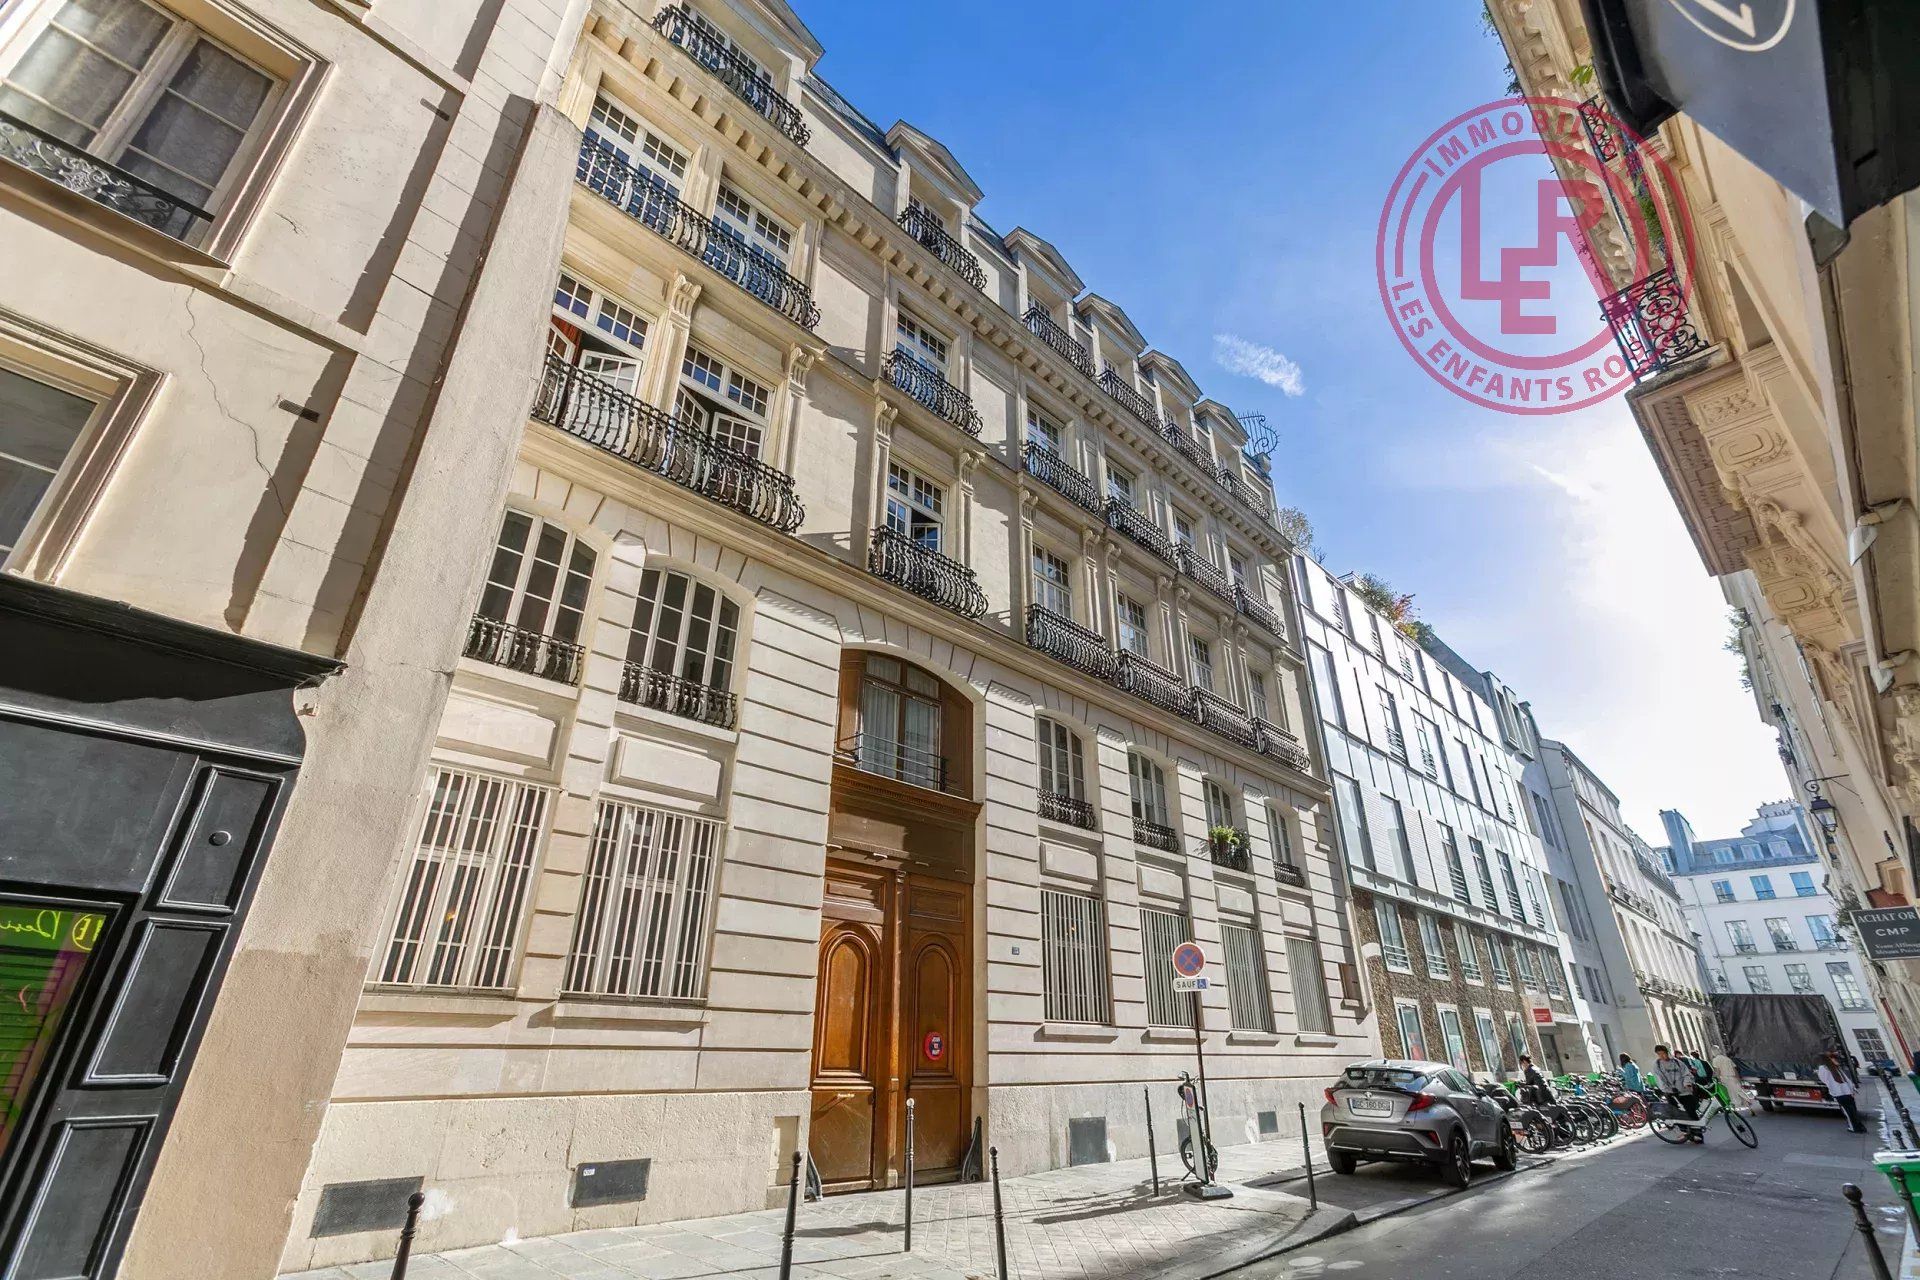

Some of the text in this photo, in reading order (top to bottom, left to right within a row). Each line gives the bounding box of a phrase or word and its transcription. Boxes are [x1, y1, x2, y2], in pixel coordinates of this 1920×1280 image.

[1857, 911, 1917, 923] ACHAT OR
[1875, 927, 1910, 937] CMP
[1176, 980, 1196, 989] SAUF
